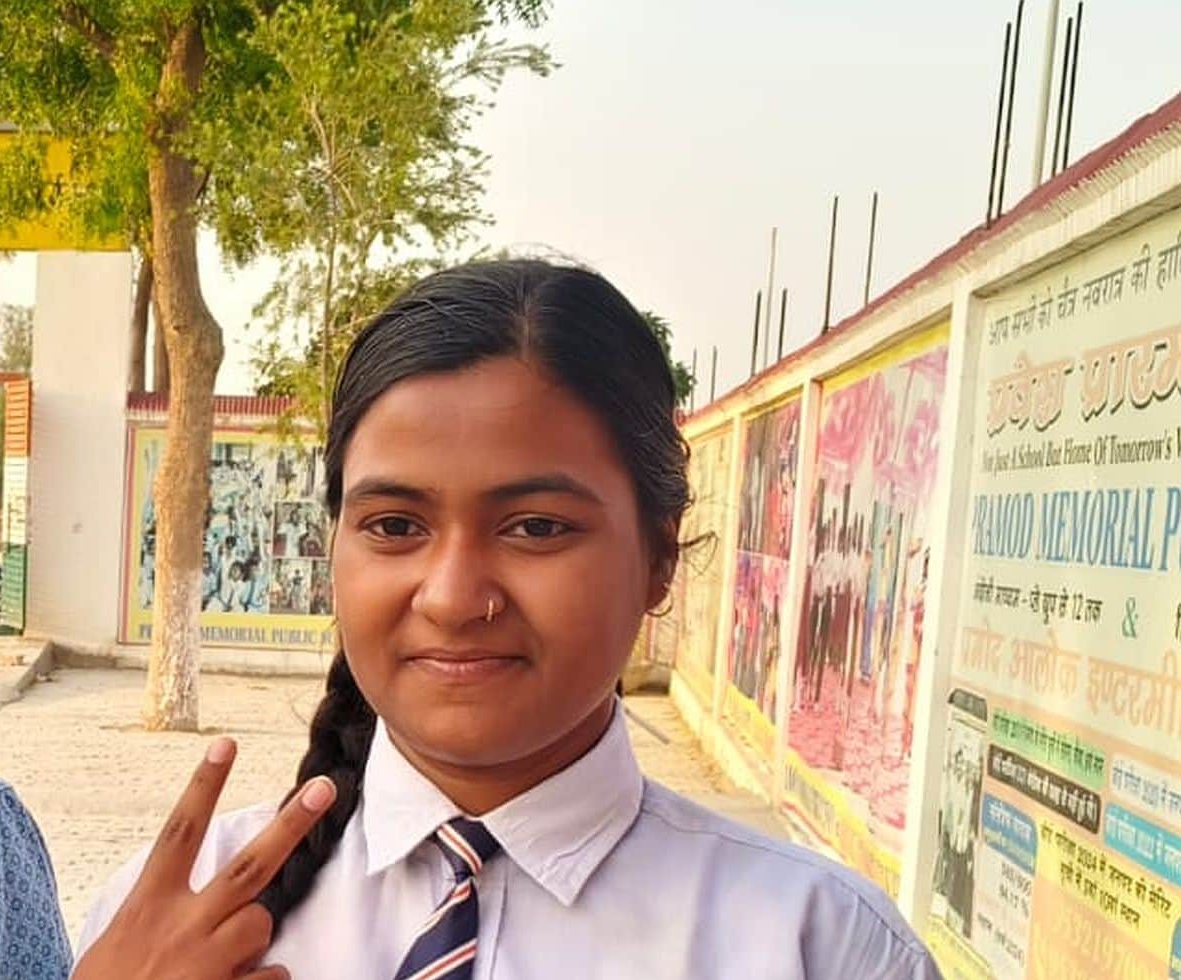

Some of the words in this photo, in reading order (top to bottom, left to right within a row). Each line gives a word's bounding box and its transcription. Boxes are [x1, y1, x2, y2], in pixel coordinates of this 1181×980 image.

[1064, 438, 1092, 465] Home
[1094, 436, 1108, 464] Of
[1110, 431, 1173, 465] Tomorrow's
[1040, 487, 1155, 570] MEMORIAL
[1072, 592, 1084, 621] 12
[1122, 597, 1138, 639] &
[200, 625, 266, 643] MEMORIAL
[271, 628, 315, 645] PUBLIC
